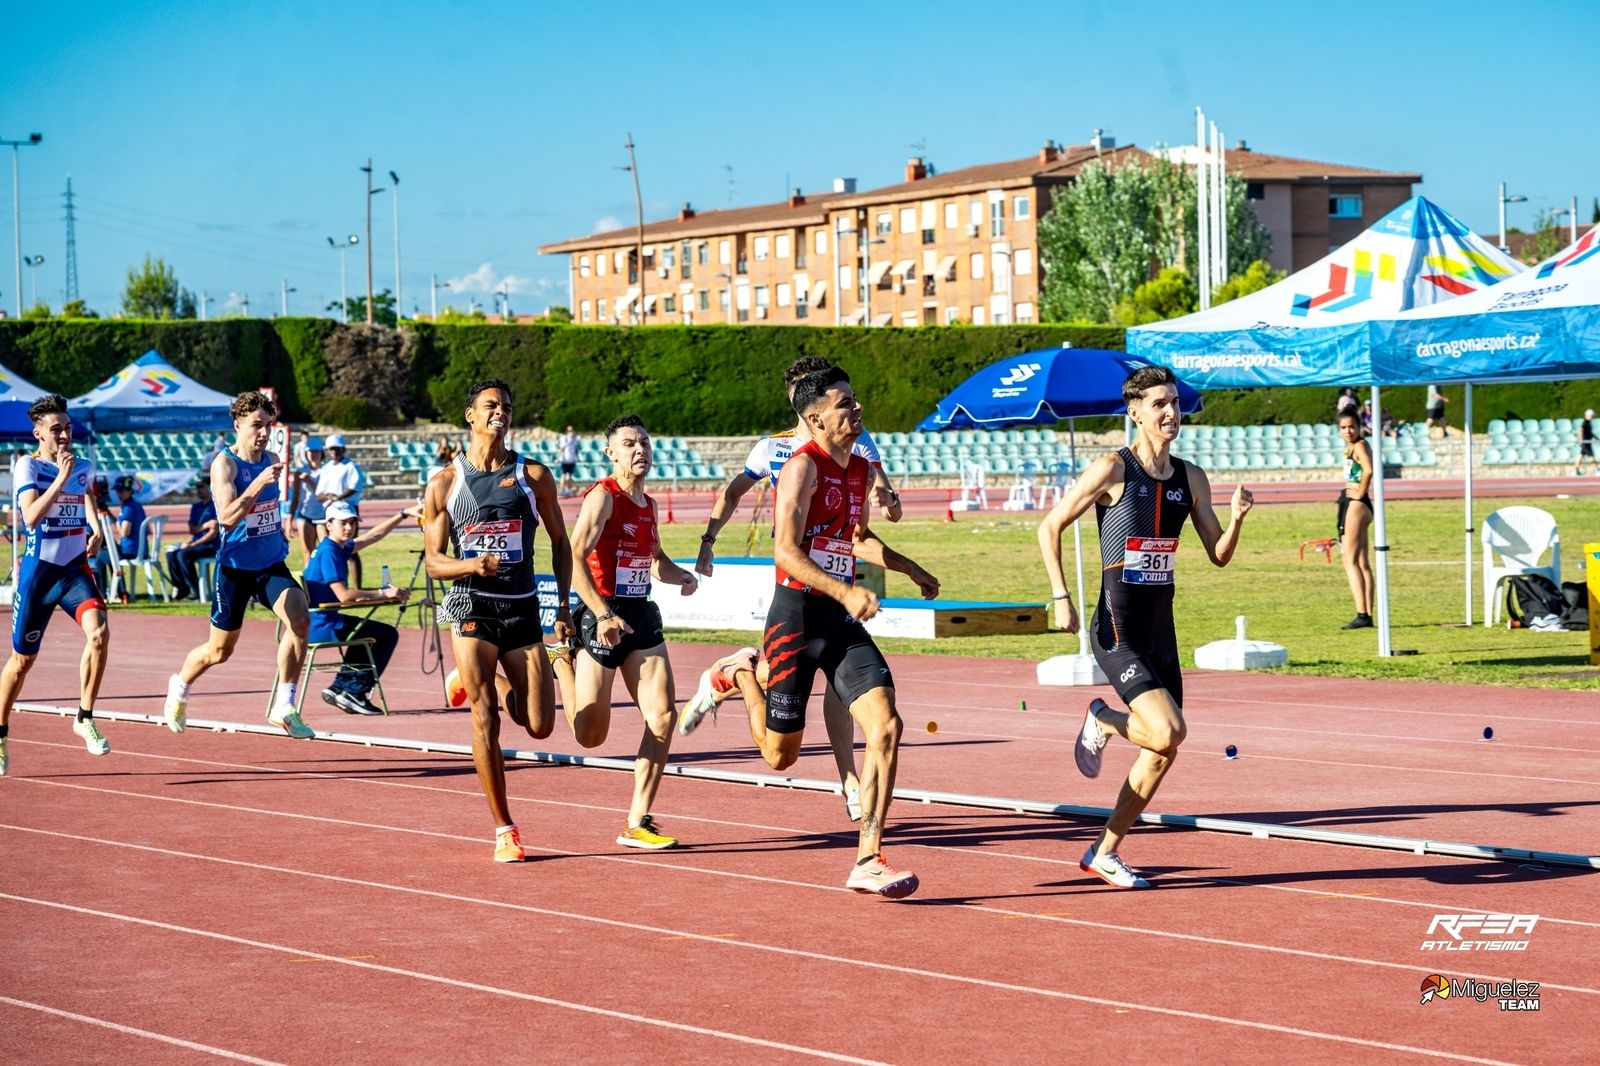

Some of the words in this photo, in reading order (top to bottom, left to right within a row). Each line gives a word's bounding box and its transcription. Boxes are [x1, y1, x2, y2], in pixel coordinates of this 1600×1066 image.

[1416, 333, 1540, 358] tarragonaesports.cat
[1172, 351, 1304, 372] tarragonaesports.cat
[59, 504, 78, 516] 207
[257, 511, 275, 526] 291
[476, 535, 508, 550] 426
[824, 555, 848, 573] 315
[1142, 554, 1169, 570] 361
[629, 570, 649, 584] 312
